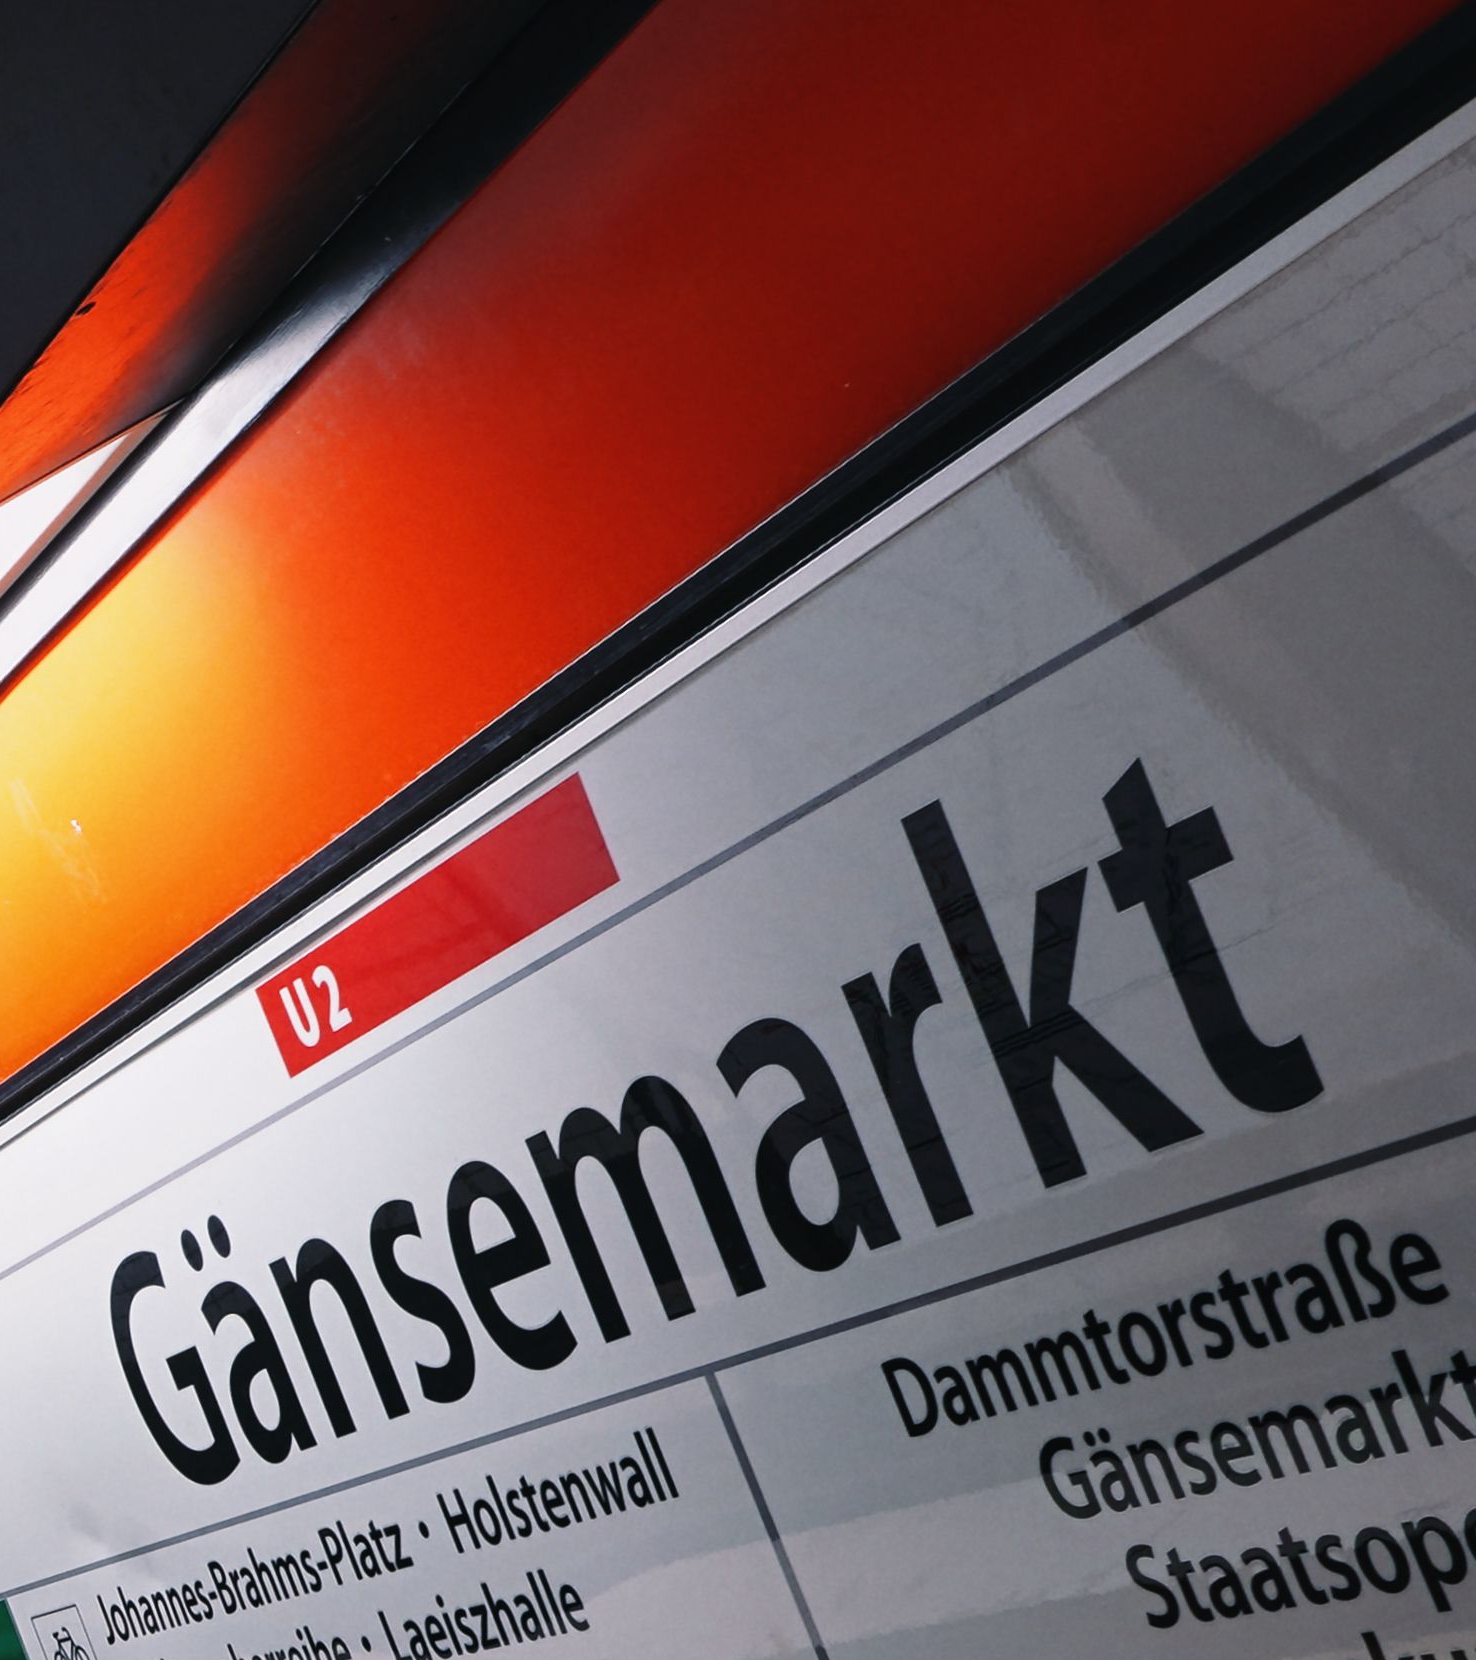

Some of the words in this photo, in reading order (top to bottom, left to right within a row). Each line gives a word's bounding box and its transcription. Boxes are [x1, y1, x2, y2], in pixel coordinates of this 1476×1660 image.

[278, 965, 353, 1049] U2
[109, 757, 1325, 1487] Gänsemarkt
[880, 1218, 1451, 1438] Dammtorstraße
[1038, 1349, 1476, 1520] Gänsemarkt
[97, 1519, 414, 1646] Johannes-Brahms-Platz
[436, 1426, 680, 1555] Holstenwall
[1125, 1508, 1476, 1629] Staatsop
